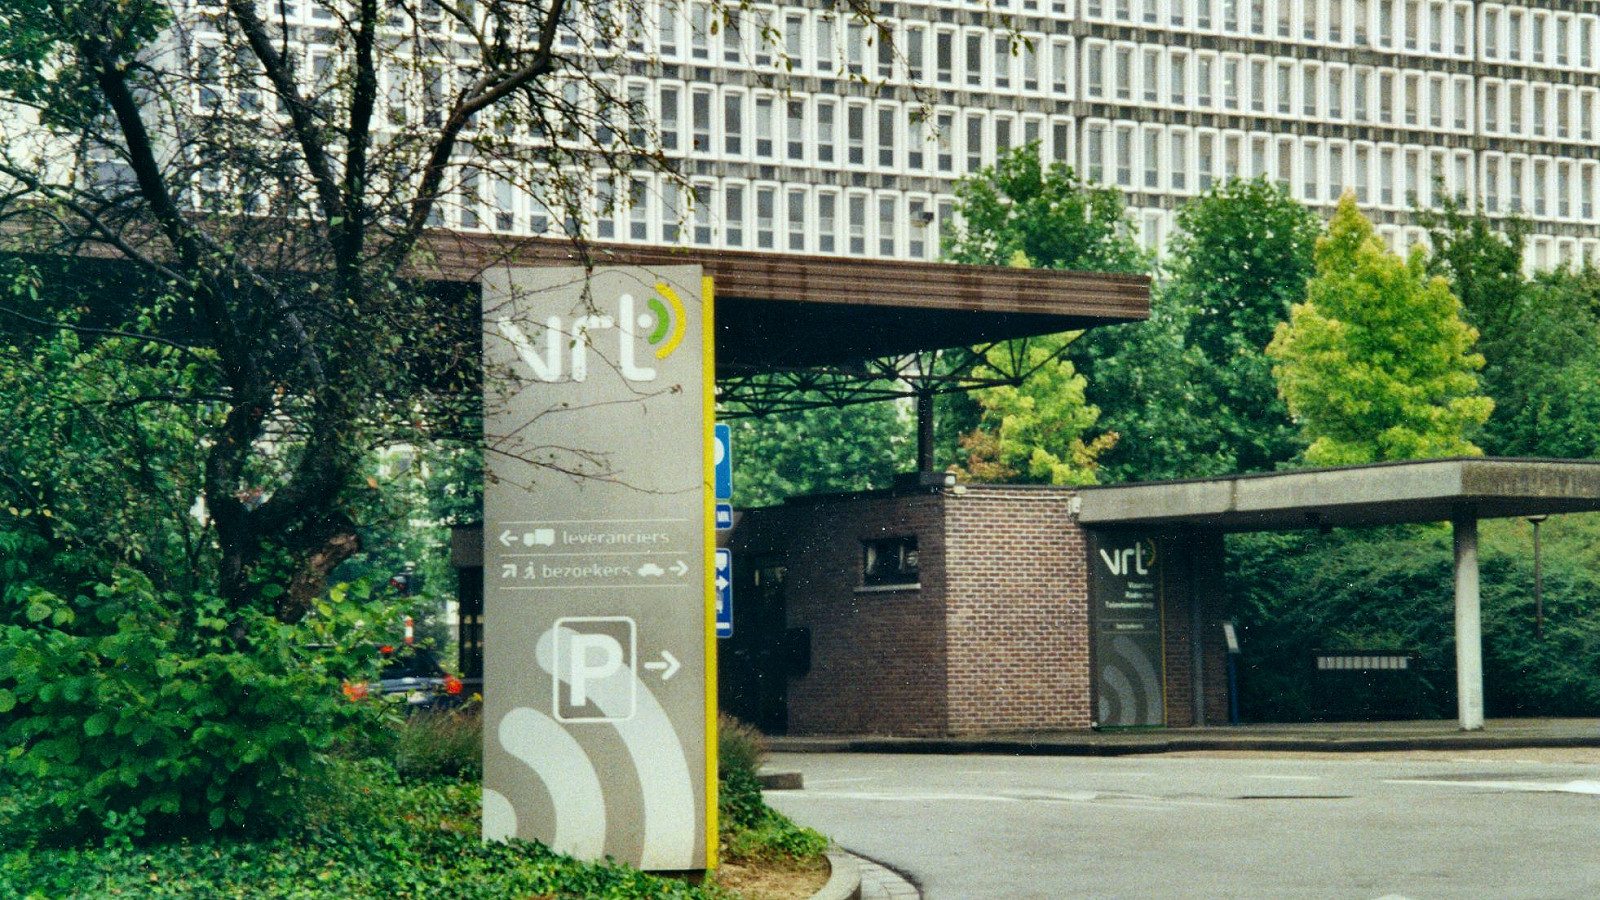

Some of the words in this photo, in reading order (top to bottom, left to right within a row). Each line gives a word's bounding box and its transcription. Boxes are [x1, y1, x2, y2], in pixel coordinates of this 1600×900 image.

[498, 293, 656, 382] vrt
[563, 530, 670, 545] leveranciers
[542, 562, 631, 579] bezoekers
[1100, 542, 1148, 575] vrt
[571, 633, 623, 706] P
